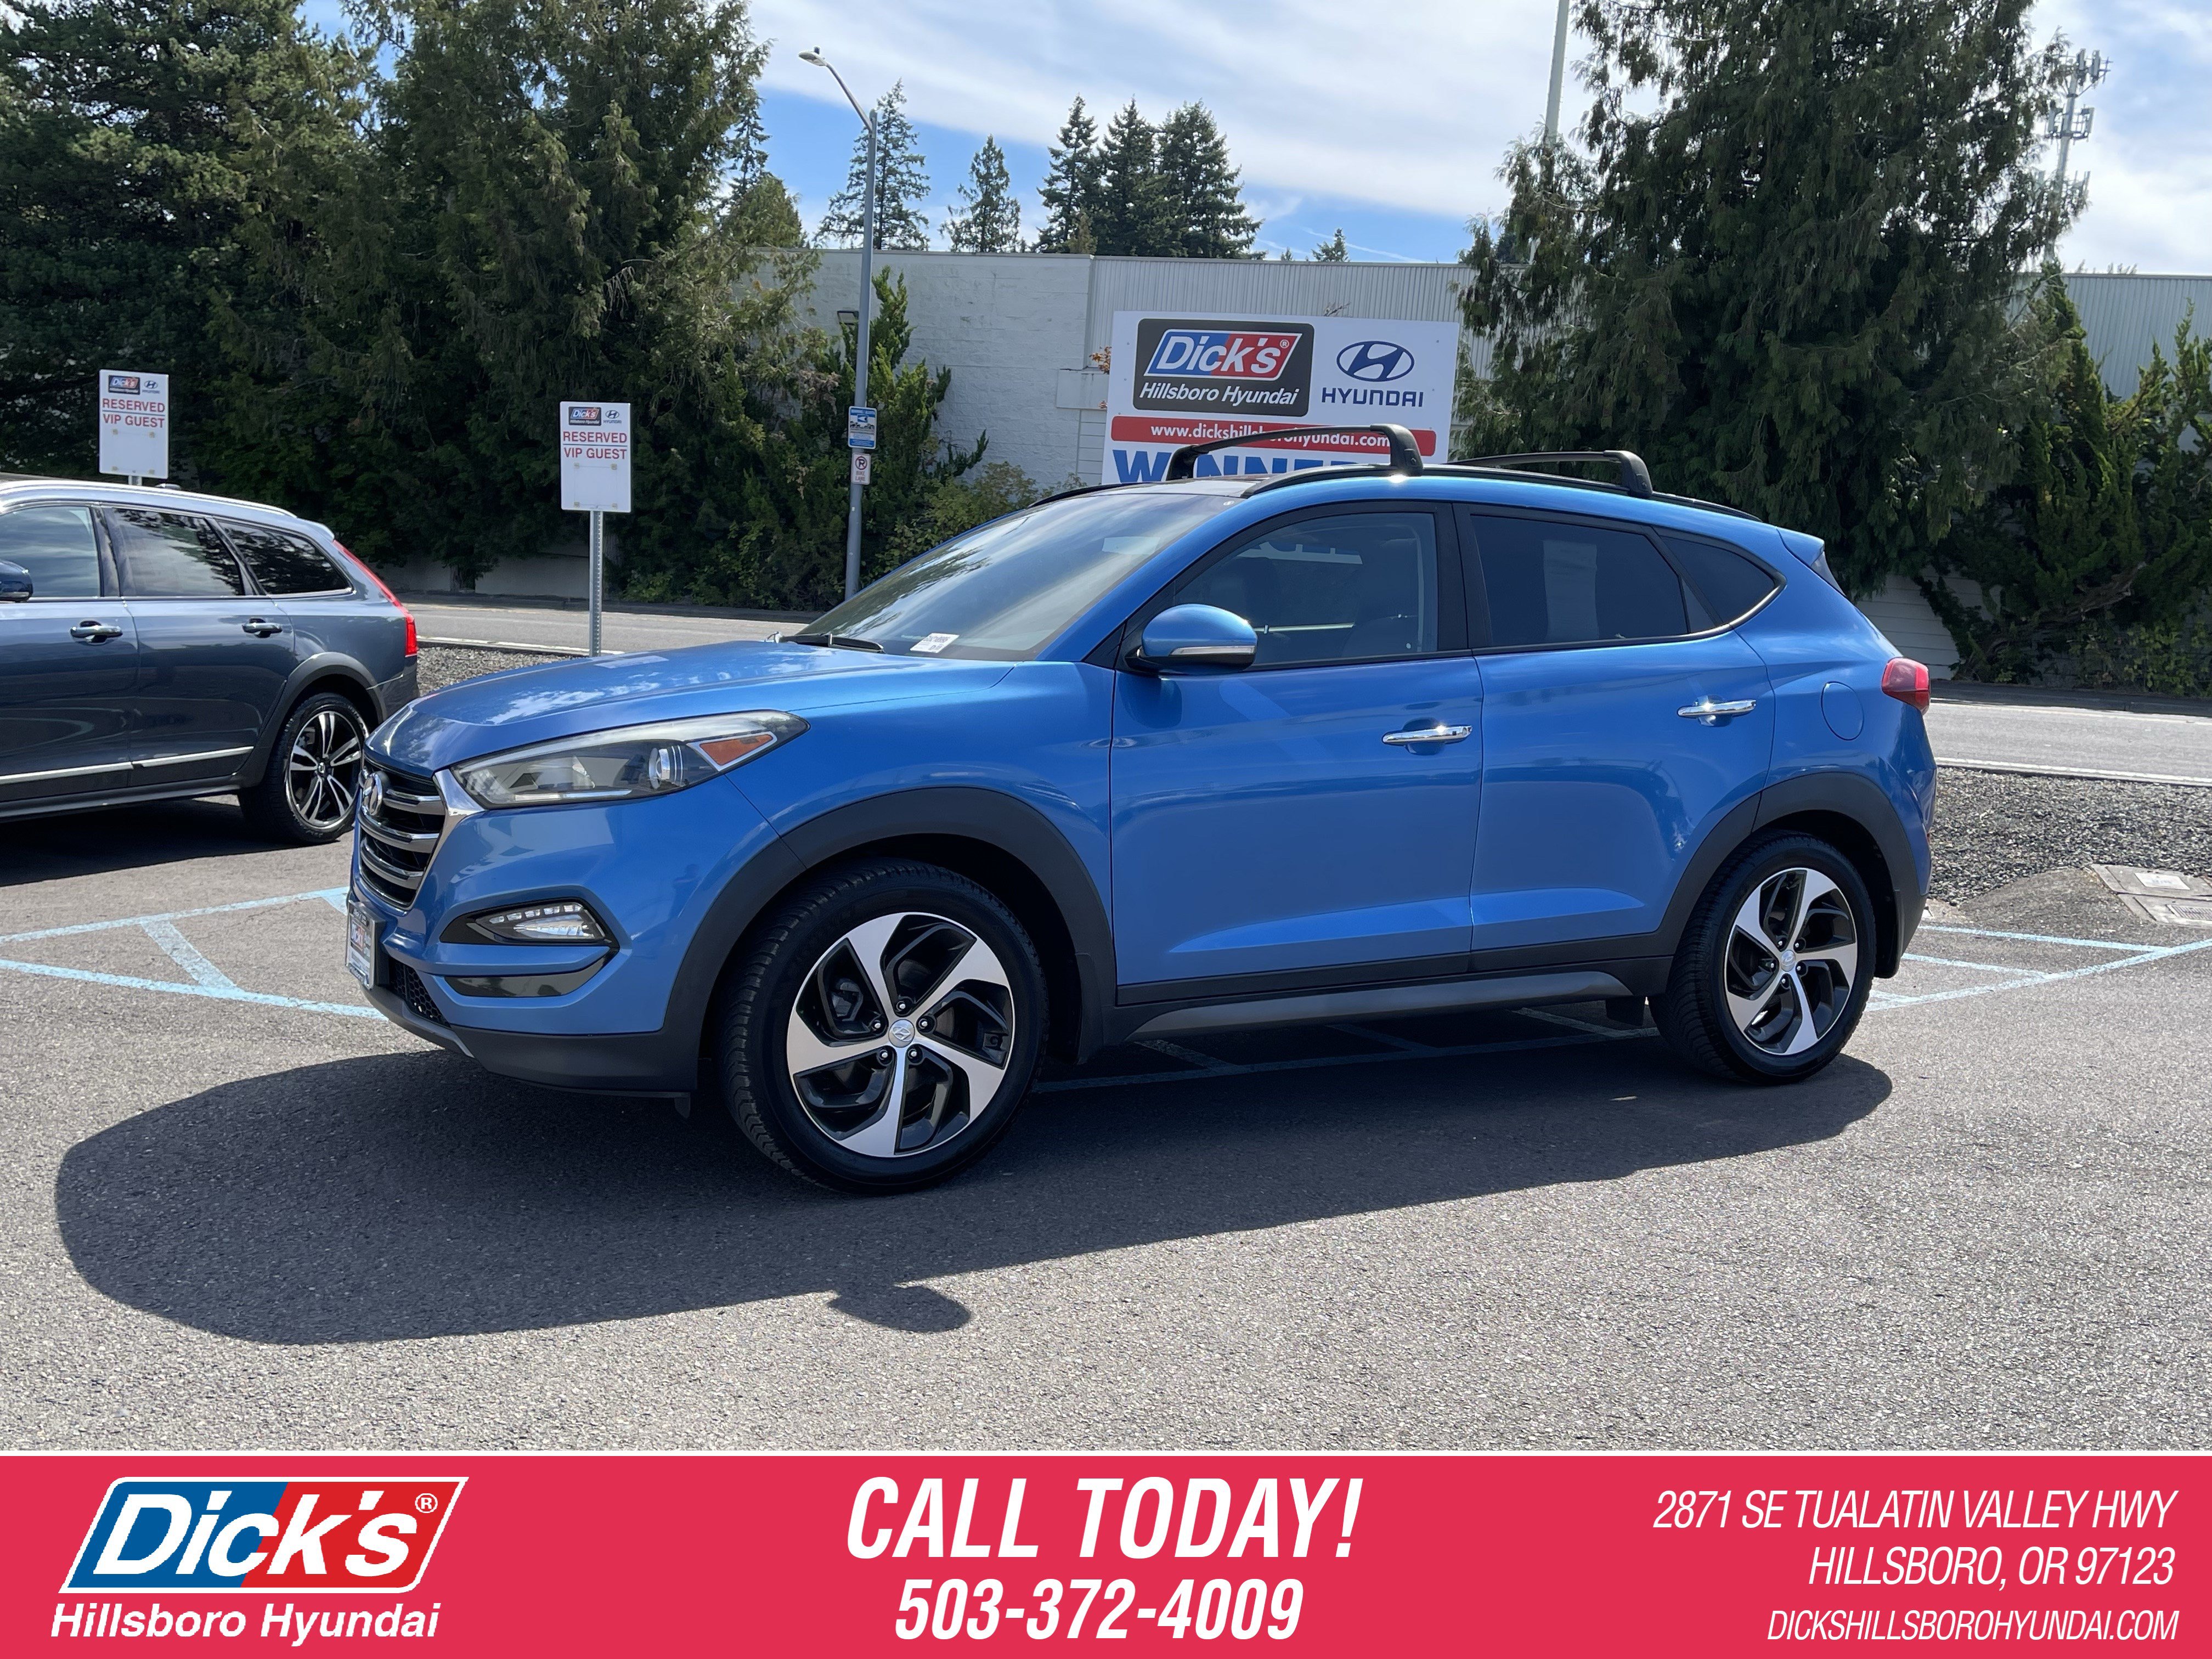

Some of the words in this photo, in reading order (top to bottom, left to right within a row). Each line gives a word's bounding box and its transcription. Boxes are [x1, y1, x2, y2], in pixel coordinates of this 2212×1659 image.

[1156, 335, 1281, 374] Dick's
[1139, 382, 1219, 401] Hillsboro
[1222, 386, 1300, 407] Hyundai
[1322, 387, 1424, 407] HYUNDAI
[103, 398, 165, 413] RESERVED
[103, 414, 121, 424] VIP
[125, 415, 165, 428] GUEST
[563, 431, 627, 443] RESERVED
[563, 447, 582, 458] VIP
[586, 448, 627, 459] GUEST
